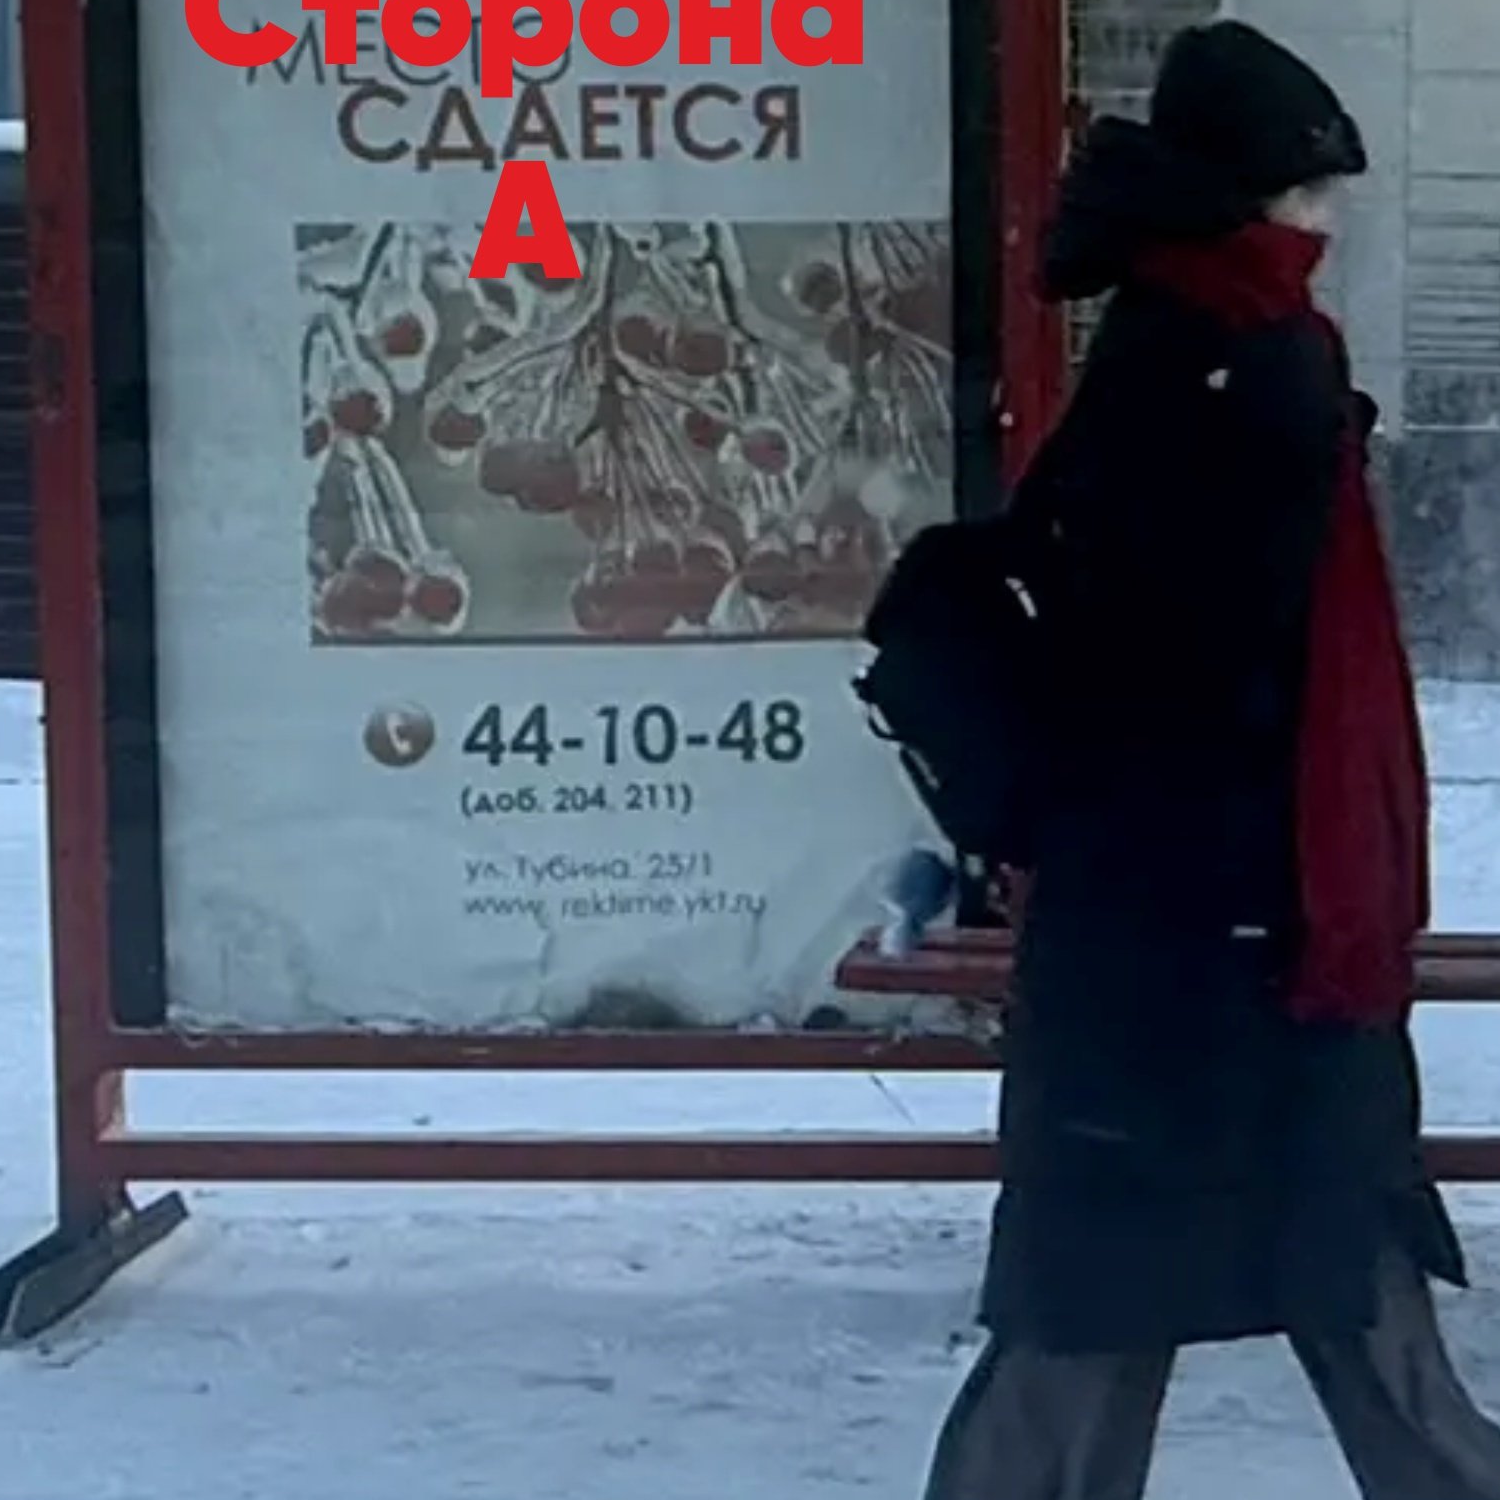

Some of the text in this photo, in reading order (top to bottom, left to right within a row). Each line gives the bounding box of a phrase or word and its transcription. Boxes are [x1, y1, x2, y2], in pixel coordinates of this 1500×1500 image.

[337, 83, 802, 172] СДАЕТСЯ
[461, 700, 804, 766] 44-10-48
[624, 782, 694, 815] 211)
